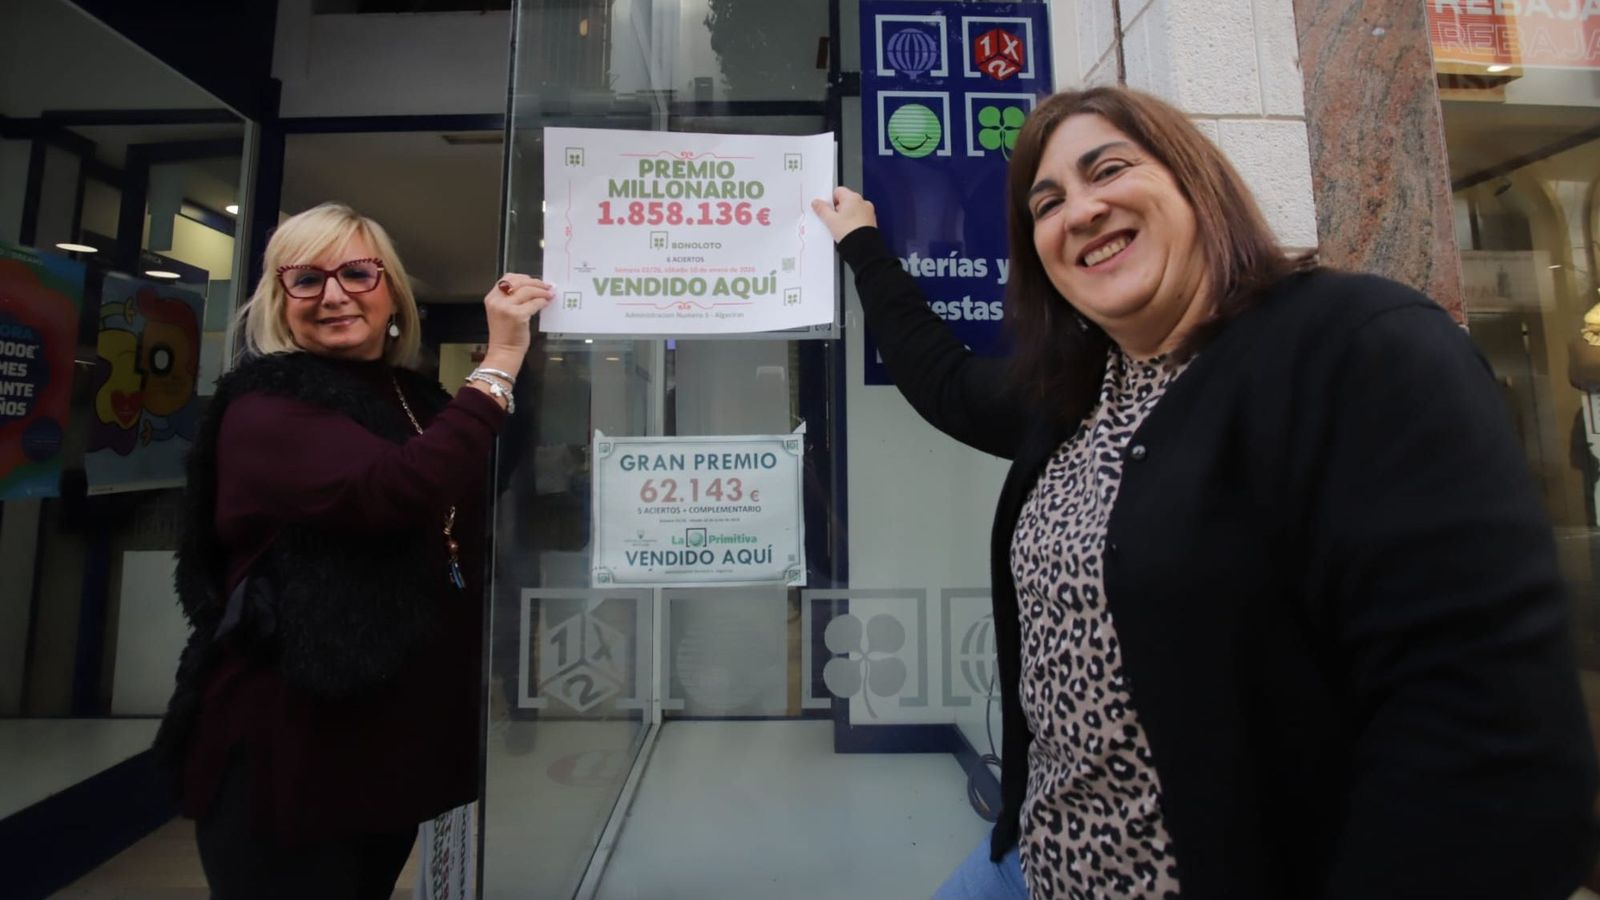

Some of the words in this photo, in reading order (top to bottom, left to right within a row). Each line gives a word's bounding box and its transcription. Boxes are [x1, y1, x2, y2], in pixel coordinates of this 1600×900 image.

[638, 159, 735, 179] PREMIO
[608, 179, 765, 200] MILLONARIO
[671, 241, 722, 250] BONOLOTO
[592, 277, 707, 297] VENDIDO
[712, 269, 777, 299] AQUÍ
[927, 295, 1004, 321] estas
[0, 380, 34, 397] NTE
[620, 454, 685, 472] GRAN
[694, 452, 777, 471] PREMIO
[640, 477, 744, 504] 62.143
[750, 489, 760, 502] €
[643, 506, 681, 515] ACIERTOS
[689, 505, 762, 514] COMPLEMENTARIO
[672, 535, 685, 545] La
[709, 534, 758, 545] Primitiva
[625, 549, 715, 567] VENDIDO
[722, 544, 772, 566] AQUÍ
